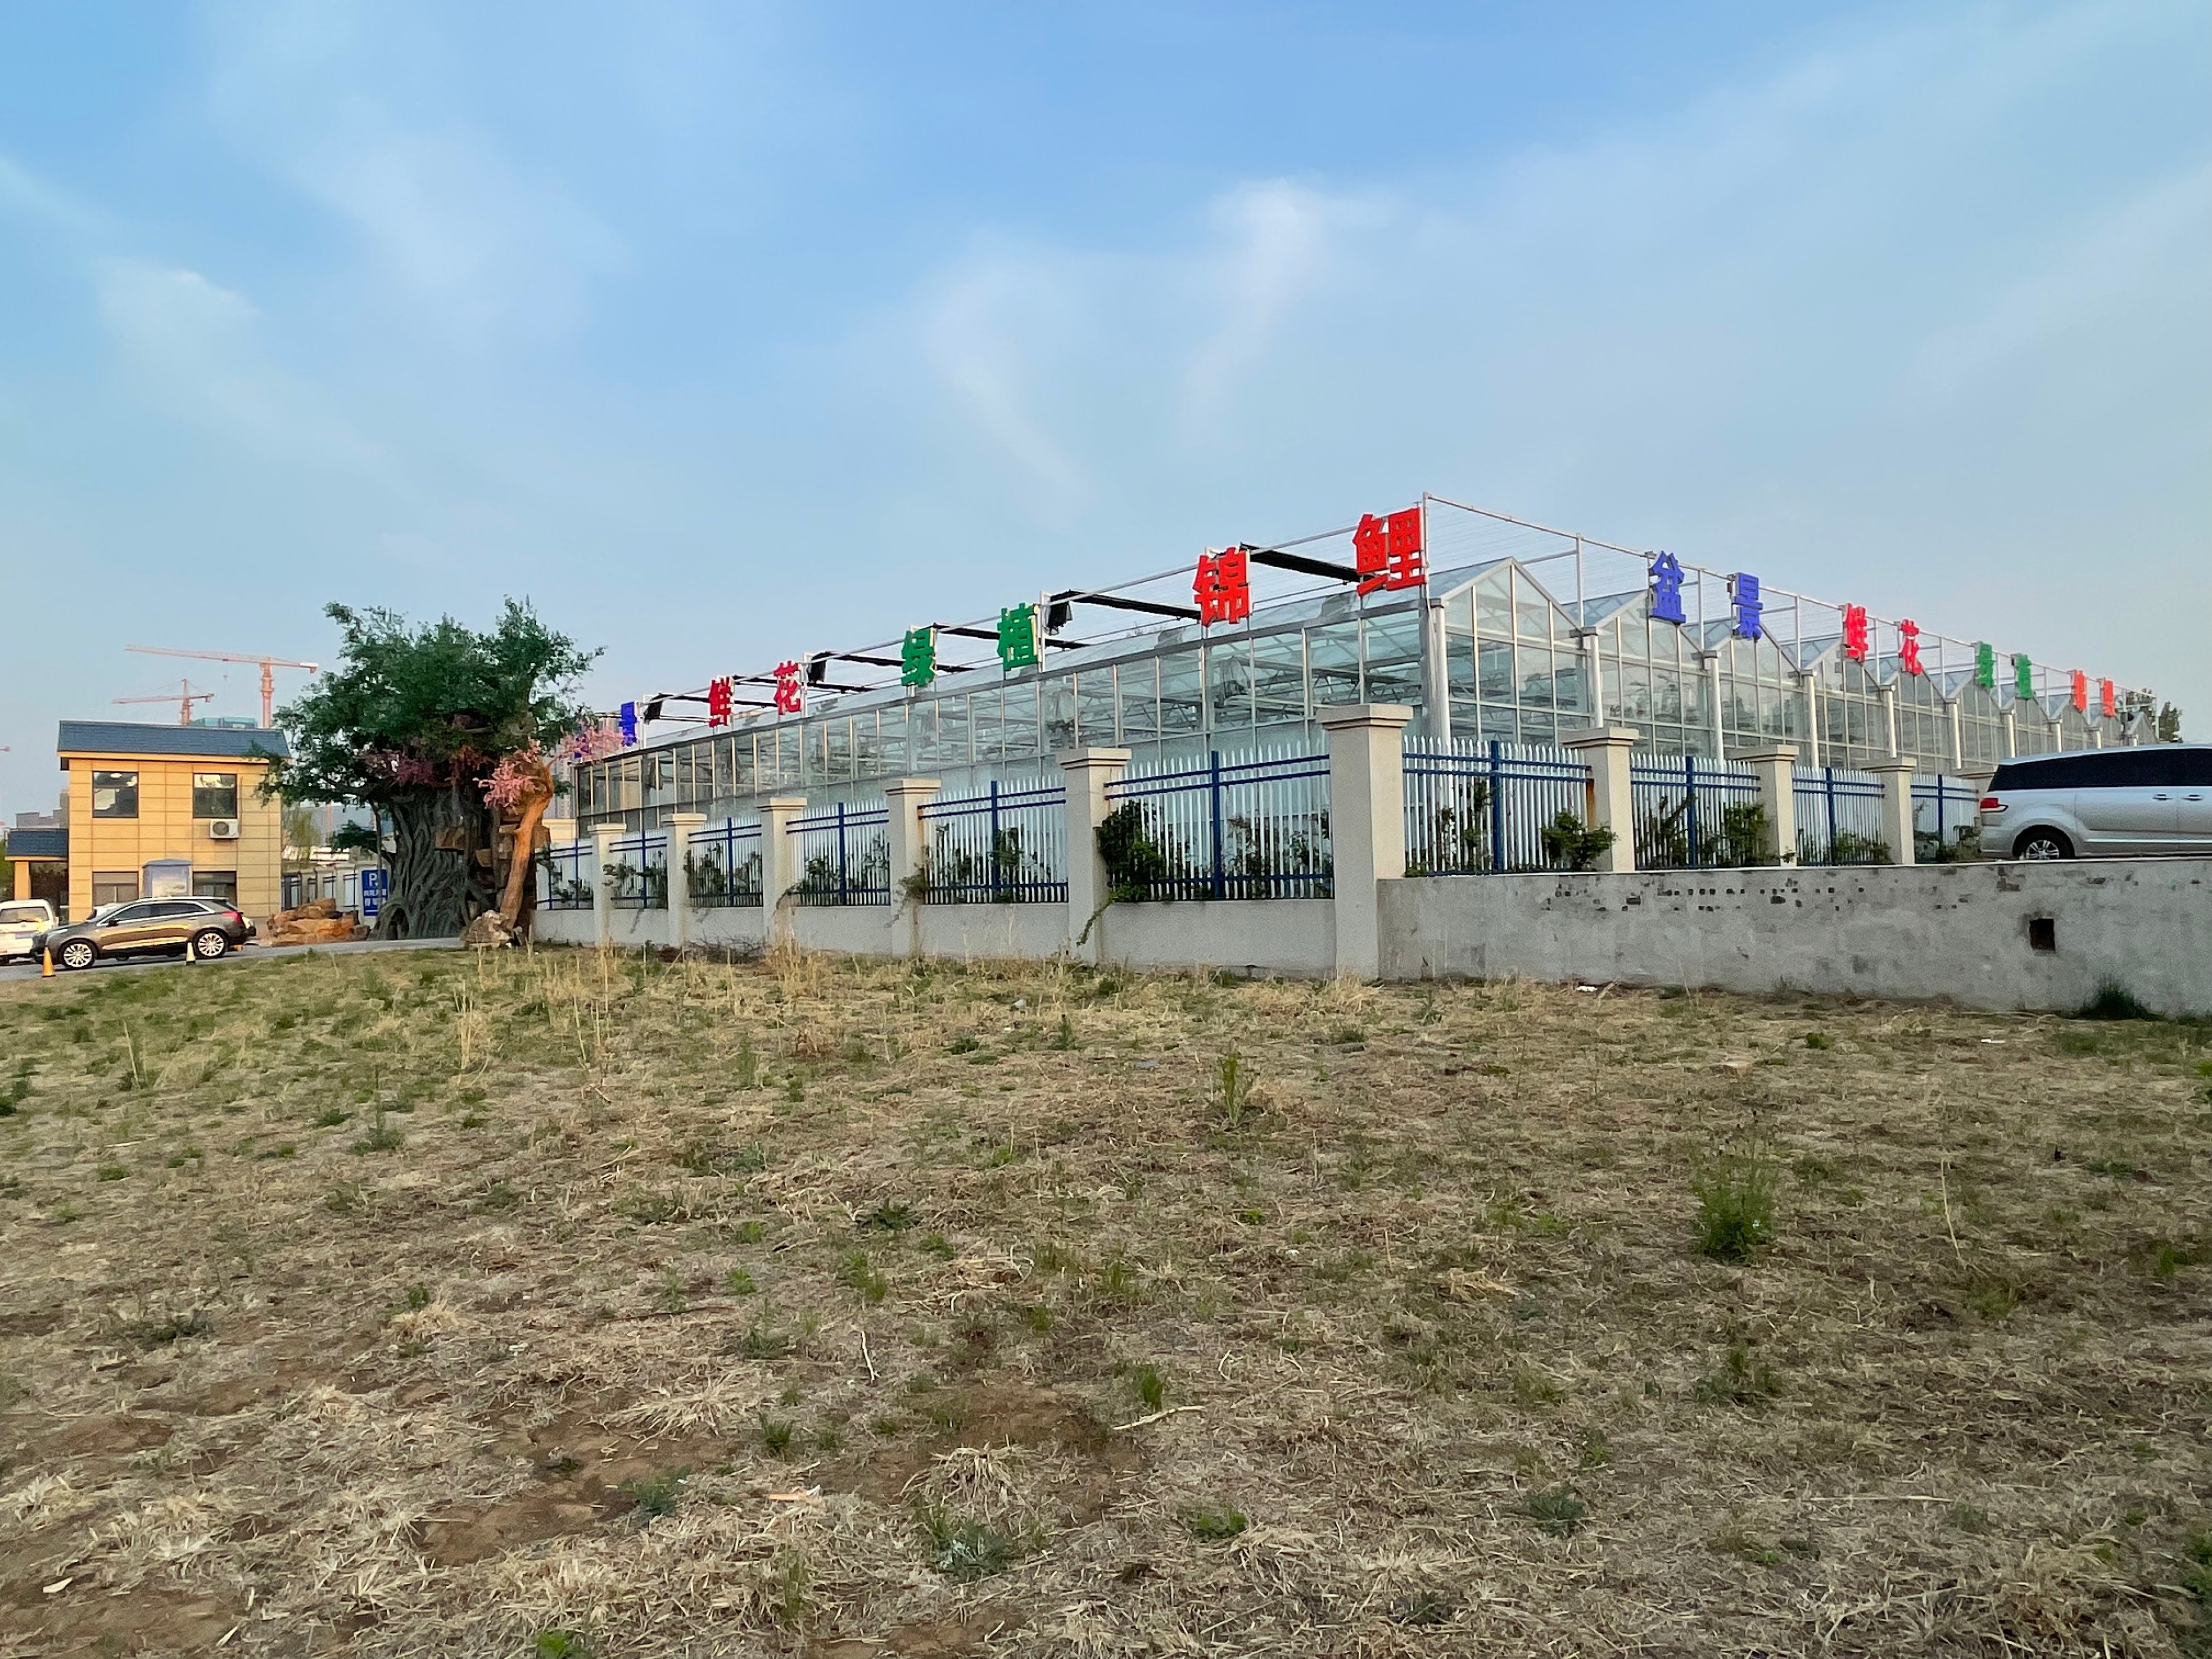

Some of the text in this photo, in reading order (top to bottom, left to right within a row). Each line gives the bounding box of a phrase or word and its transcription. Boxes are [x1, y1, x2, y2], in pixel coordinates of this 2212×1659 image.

[707, 662, 802, 727] 鲜花
[900, 603, 1039, 688] 绿植
[1191, 507, 1426, 627] 锦鲤
[1648, 550, 1764, 640] 盆景
[1843, 602, 1924, 676] 鲜花
